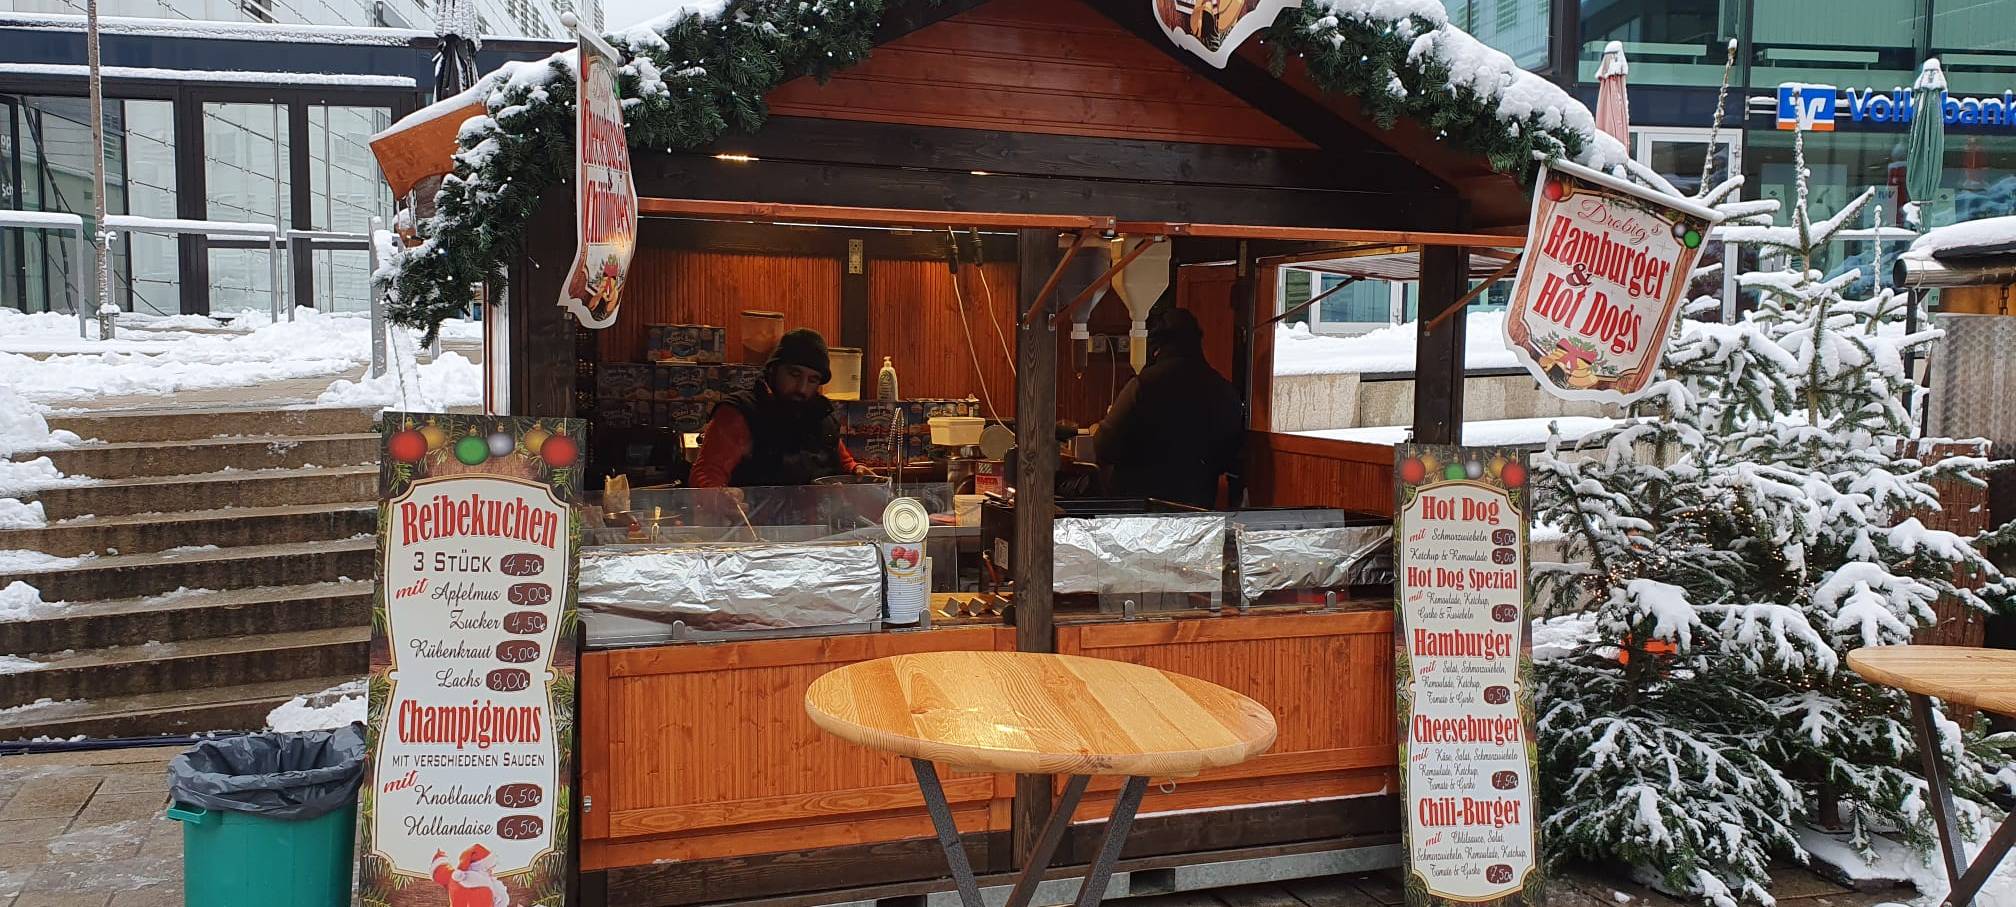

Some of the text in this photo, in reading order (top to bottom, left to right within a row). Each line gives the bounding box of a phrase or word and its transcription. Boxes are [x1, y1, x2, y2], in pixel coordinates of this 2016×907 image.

[1543, 214, 1670, 300] Hamburger
[1565, 262, 1594, 287] &
[1532, 272, 1642, 354] Hot Dogs
[401, 494, 558, 549] Reibekuchen
[1422, 496, 1500, 525] Hot Dog
[1409, 528, 1427, 543] mit
[1432, 528, 1488, 542] Schmorzwiebeln
[414, 552, 424, 572] 3
[1409, 547, 1439, 563] Ketchup
[1441, 550, 1448, 560] &
[1449, 548, 1488, 562] Remoulade
[1408, 567, 1518, 591] Hot Dog Spezial
[396, 578, 429, 599] mit
[432, 581, 501, 607] Apfelmus
[1409, 590, 1424, 603] mit
[450, 609, 501, 630] Zucker
[410, 638, 492, 659] Rübenkraut
[1414, 628, 1512, 660] Hamburger
[436, 668, 481, 689] Lachs
[1420, 661, 1437, 676] mit
[398, 699, 541, 749] Champignons
[1413, 714, 1520, 745] Cheeseburger
[1412, 748, 1430, 763] mit
[384, 769, 418, 793] mit
[414, 784, 497, 806] Knoblauch
[1419, 796, 1521, 828] Chili-Burger
[404, 815, 494, 837] Hollandaise
[1425, 831, 1443, 847] mit
